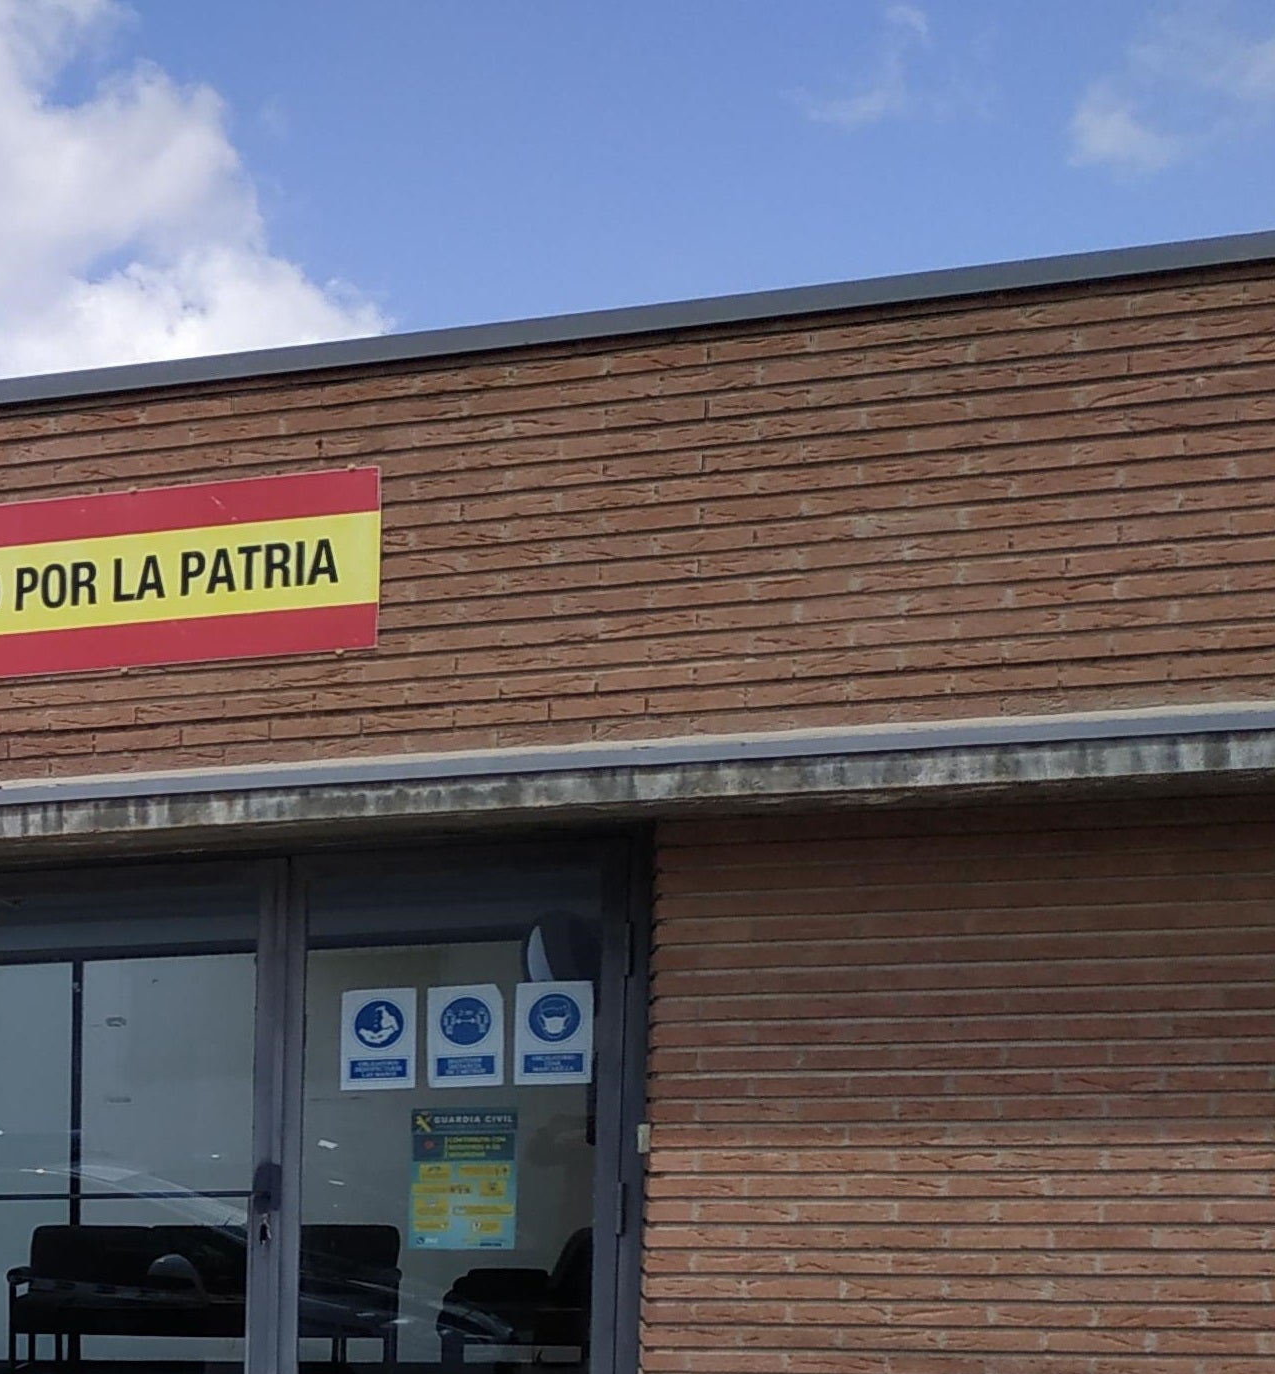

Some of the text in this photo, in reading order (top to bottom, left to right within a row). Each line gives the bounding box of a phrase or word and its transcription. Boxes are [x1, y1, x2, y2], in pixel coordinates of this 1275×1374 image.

[13, 560, 98, 613] POR
[112, 554, 166, 603] LA
[179, 537, 340, 597] PATRIA
[433, 1114, 513, 1124] GUARDIA CIVIL
